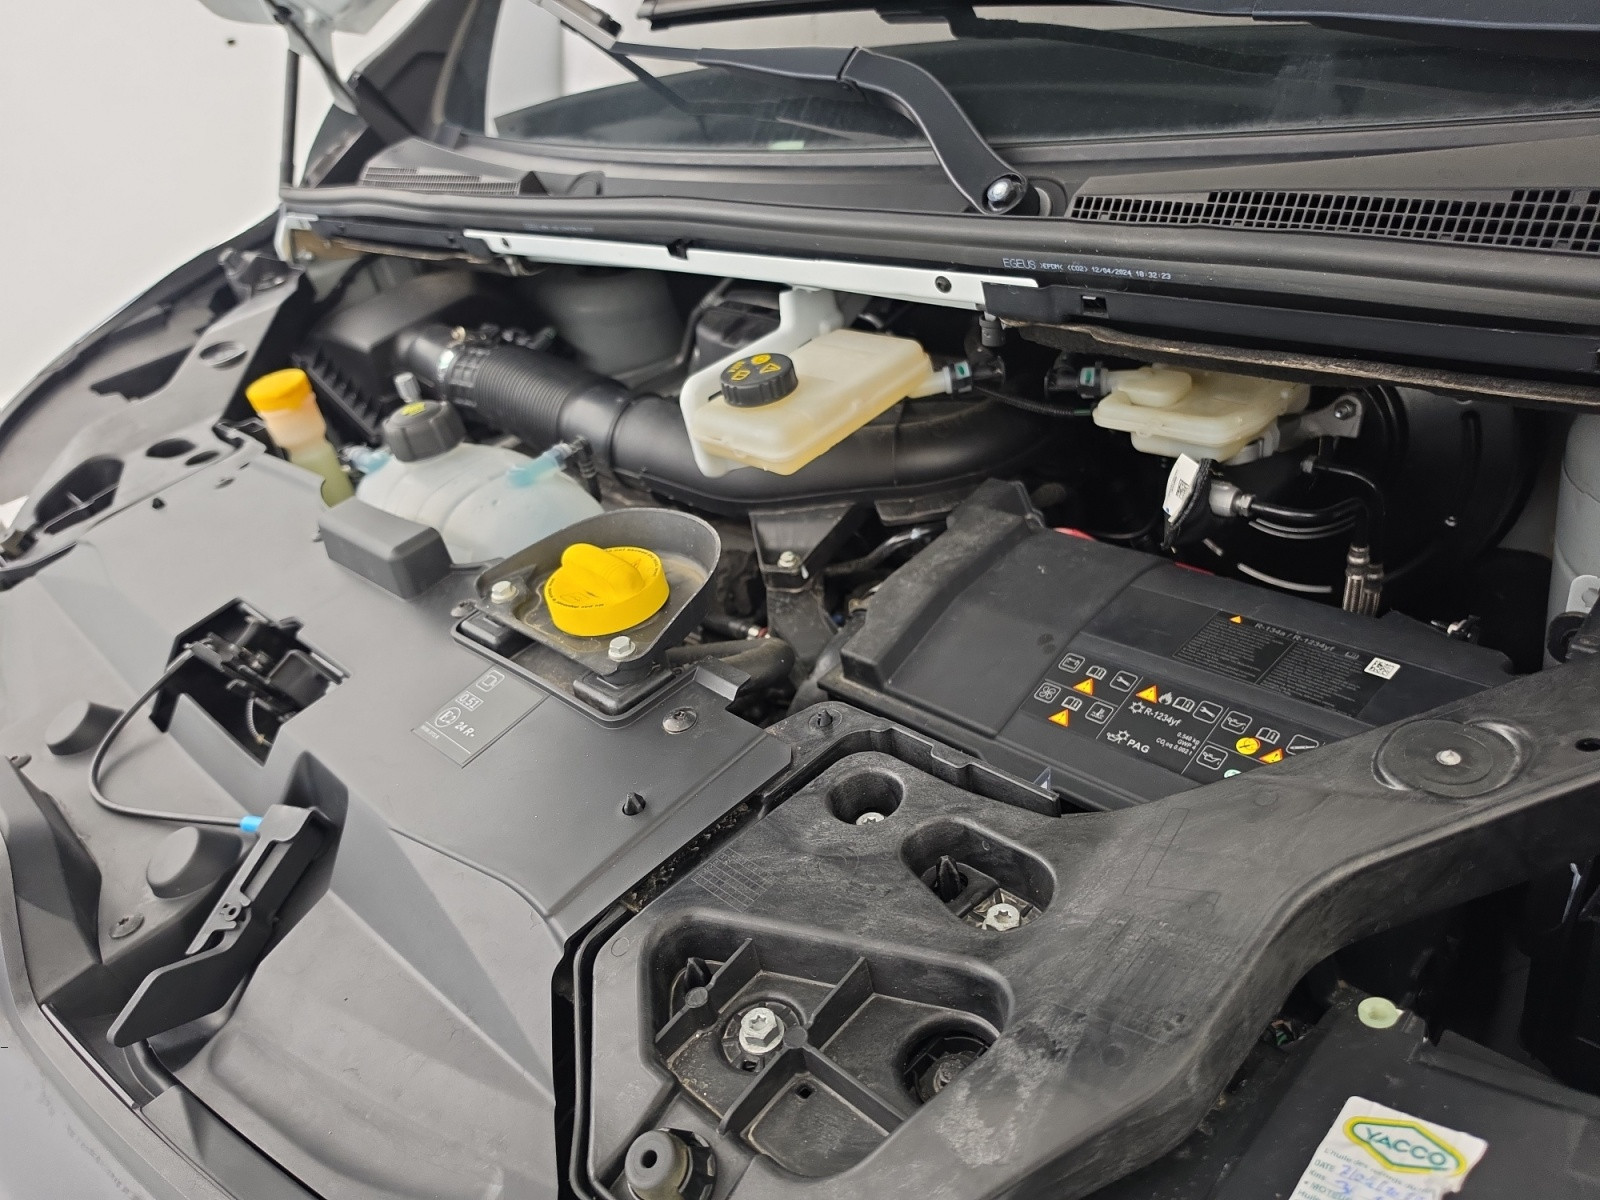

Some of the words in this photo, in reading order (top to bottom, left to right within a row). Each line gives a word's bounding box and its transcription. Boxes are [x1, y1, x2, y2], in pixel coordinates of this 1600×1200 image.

[1003, 258, 1036, 270] EGEUS
[1143, 707, 1183, 727] R-1234yf
[1126, 738, 1151, 755] PAG
[1176, 738, 1192, 749] GWP
[1365, 1127, 1447, 1165] YACCO
[1314, 1159, 1336, 1173] DATE
